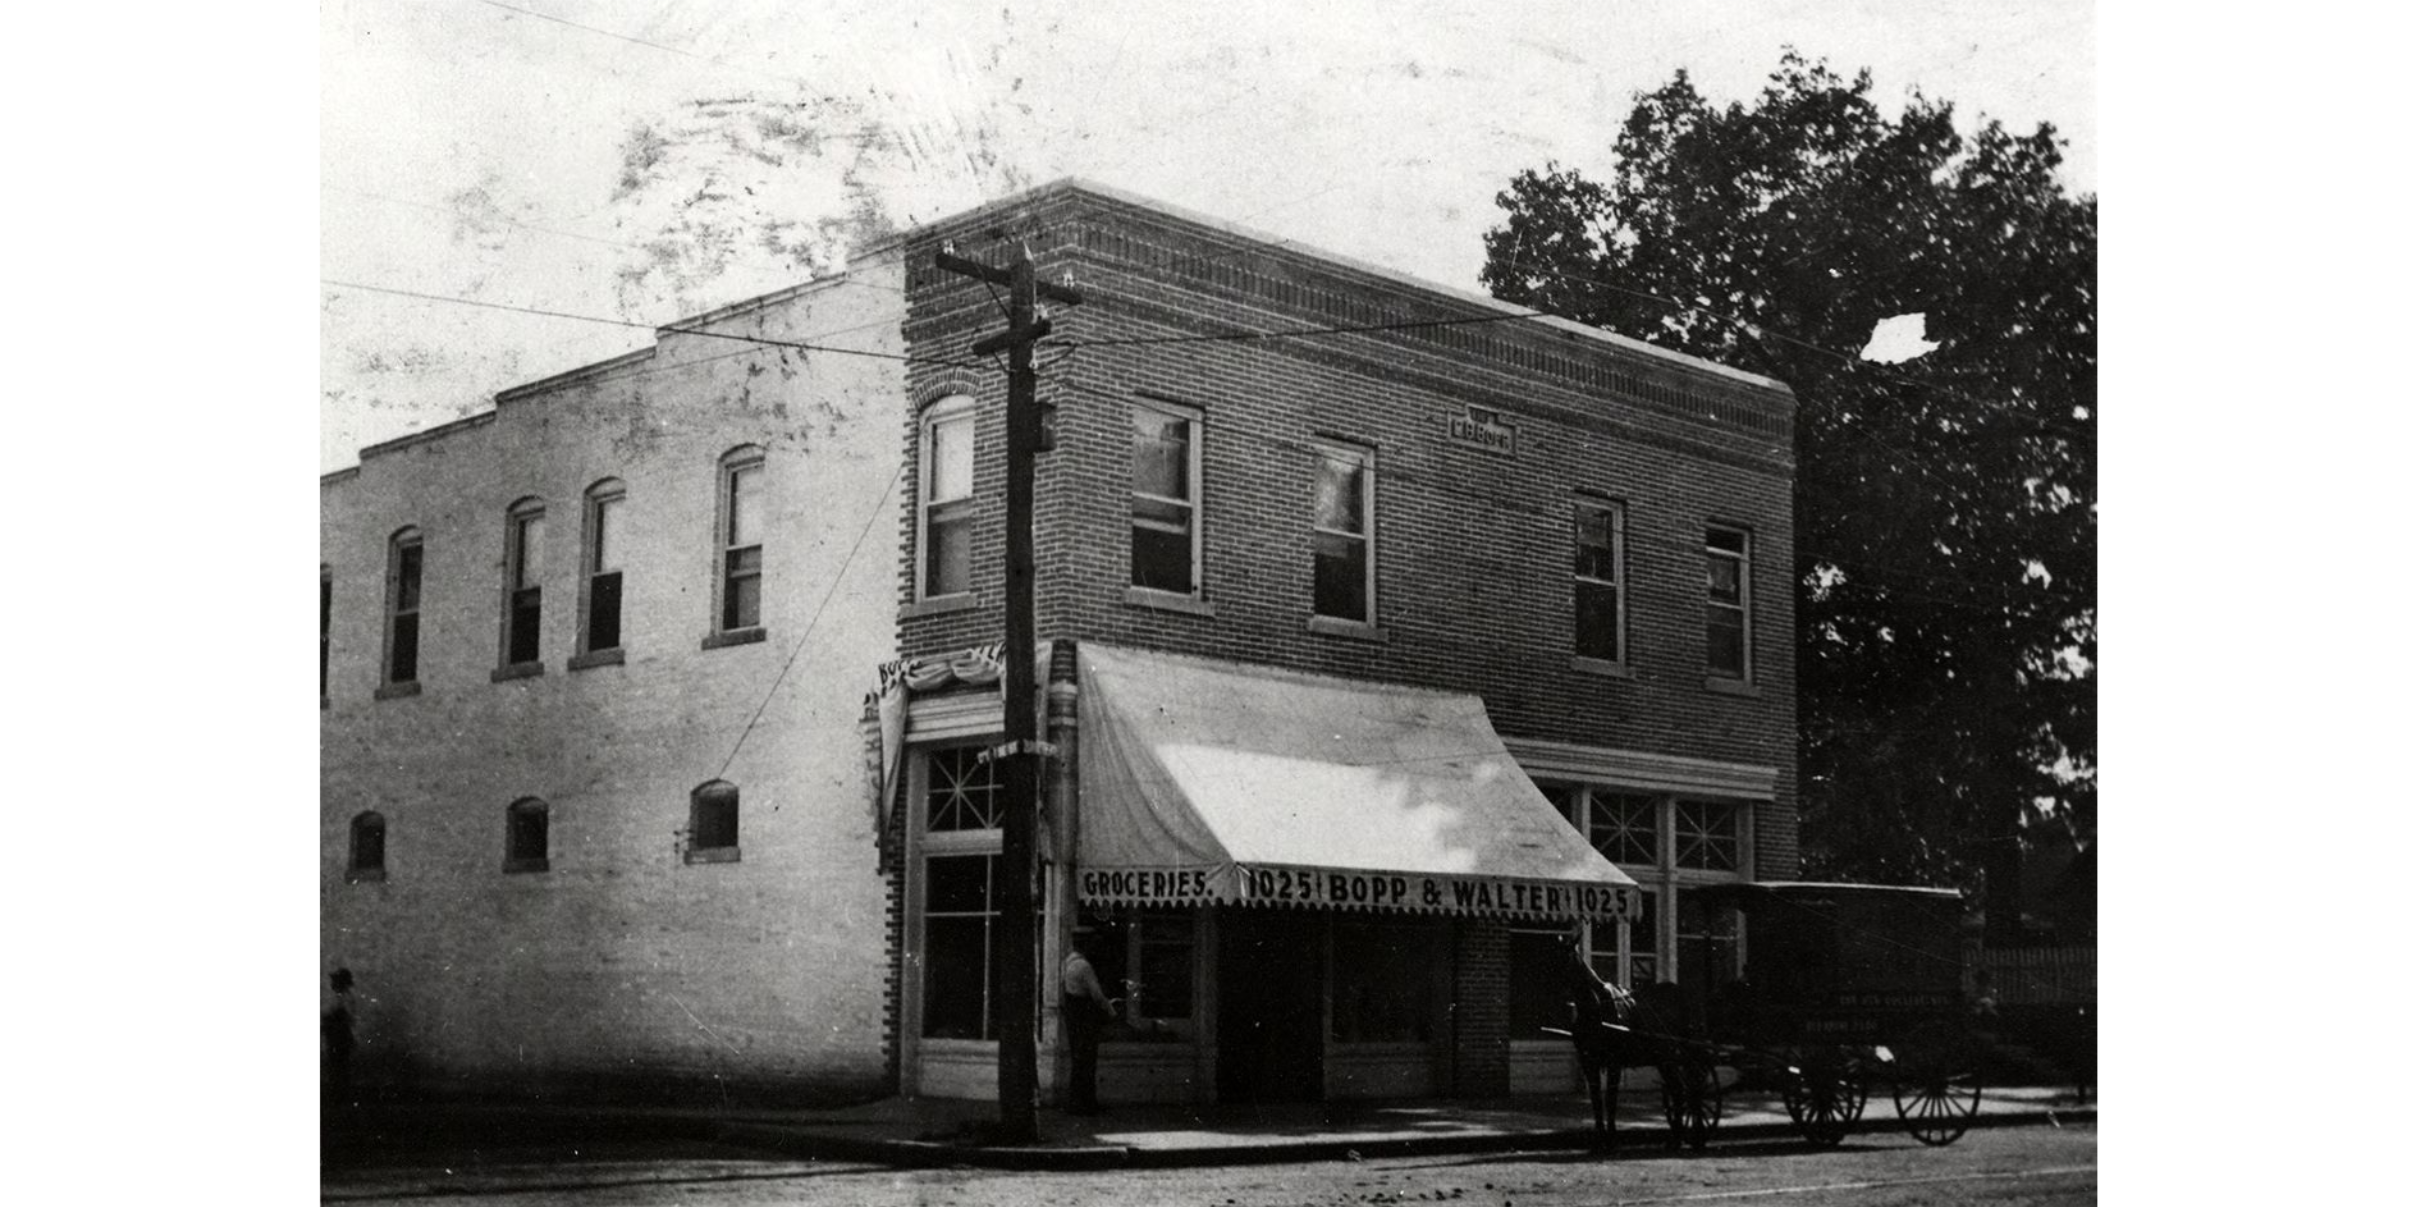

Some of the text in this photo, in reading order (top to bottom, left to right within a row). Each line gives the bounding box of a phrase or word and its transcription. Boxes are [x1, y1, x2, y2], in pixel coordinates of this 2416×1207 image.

[1084, 871, 1214, 898] GROCERIES.
[1249, 869, 1628, 914] 1025 BOPP & WALTER 1025
